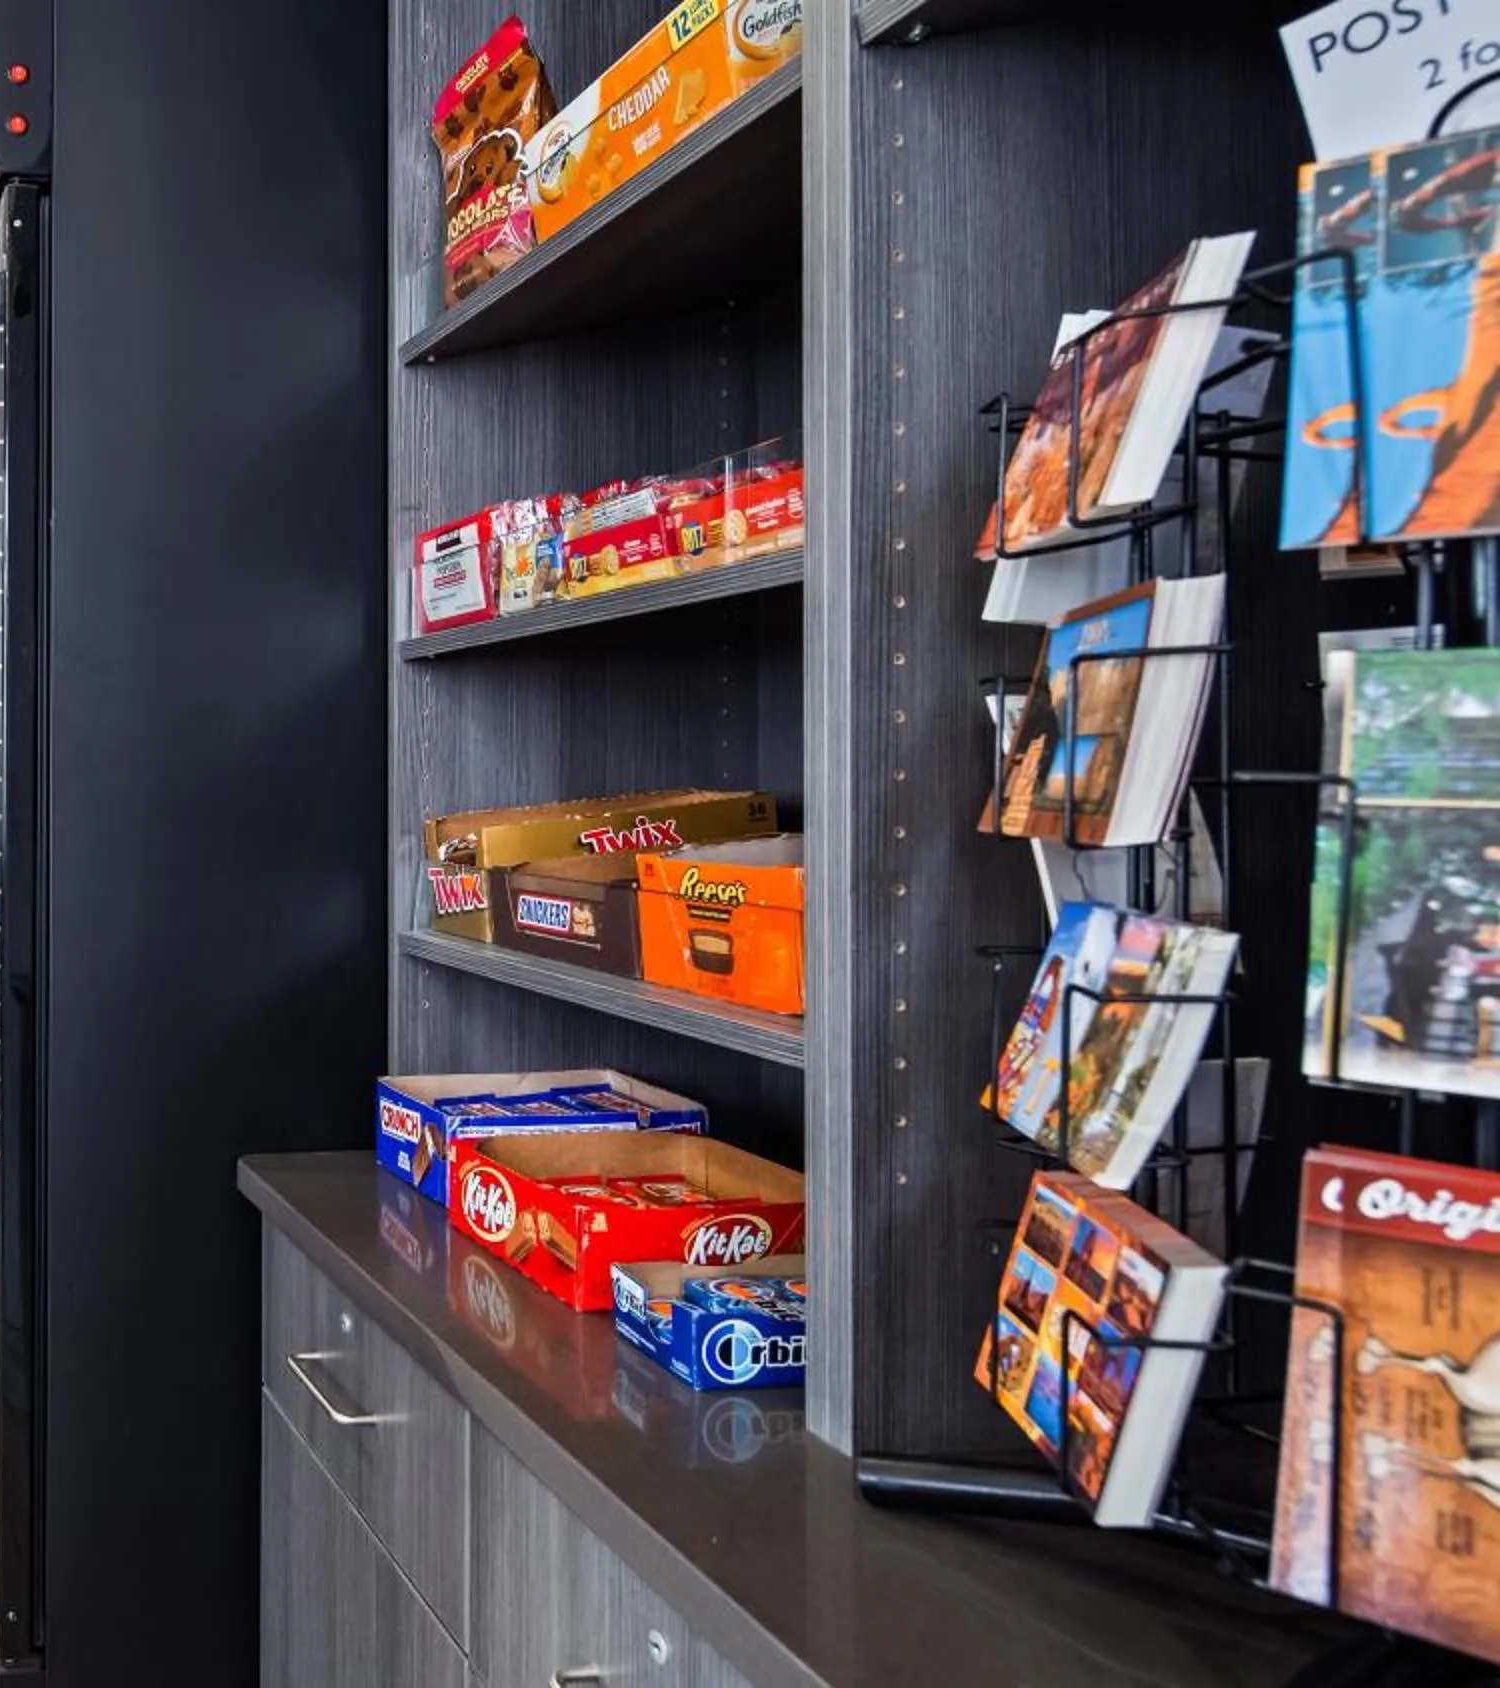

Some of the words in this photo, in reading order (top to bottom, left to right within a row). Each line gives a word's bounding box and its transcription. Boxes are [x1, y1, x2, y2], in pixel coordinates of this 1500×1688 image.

[671, 10, 692, 42] 12
[743, 1, 802, 38] Goldfish
[1419, 58, 1446, 90] 2
[608, 65, 671, 131] CHEDDAR
[579, 815, 684, 855] Twix
[519, 896, 570, 930] SNICKERS
[381, 1103, 420, 1143] CRUNCH
